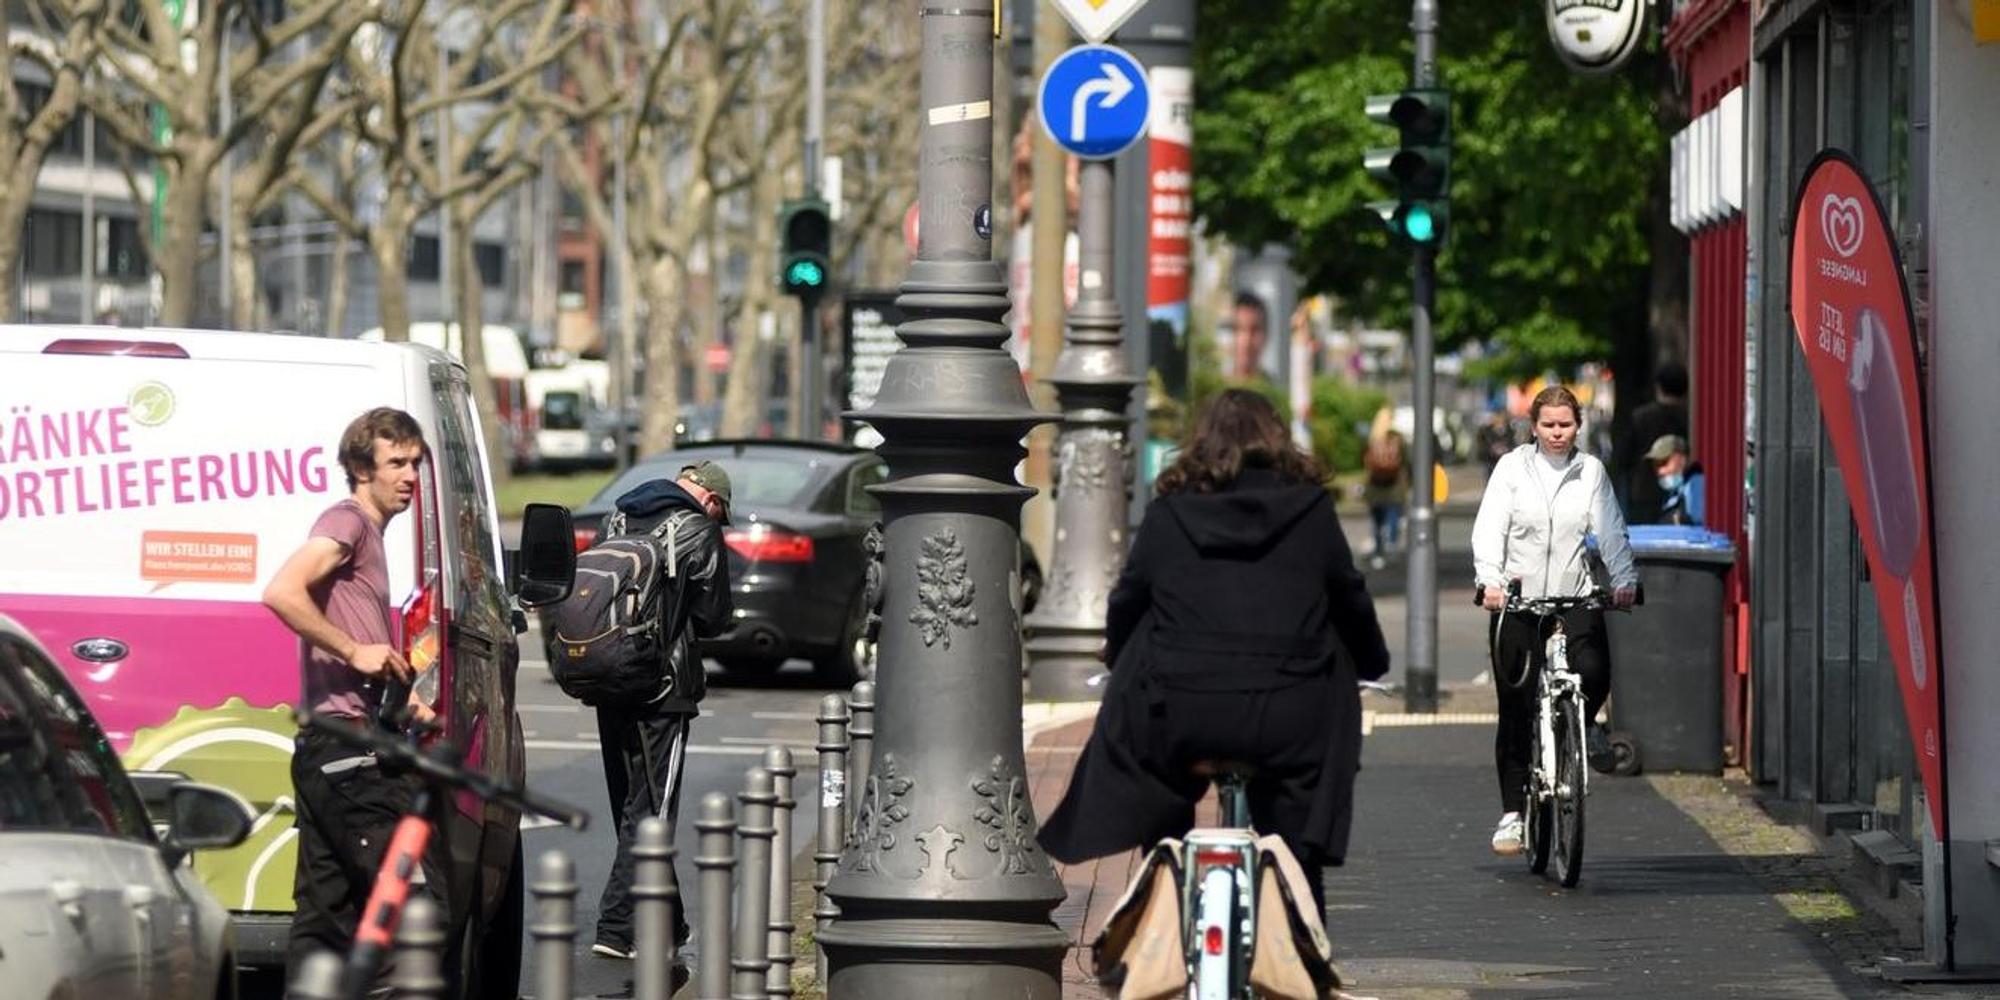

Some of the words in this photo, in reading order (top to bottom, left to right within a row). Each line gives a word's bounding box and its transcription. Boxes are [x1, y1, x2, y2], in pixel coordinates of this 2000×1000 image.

[0, 405, 132, 463] ÄNKE
[145, 541, 171, 556] WIR
[173, 542, 226, 557] STELLEN
